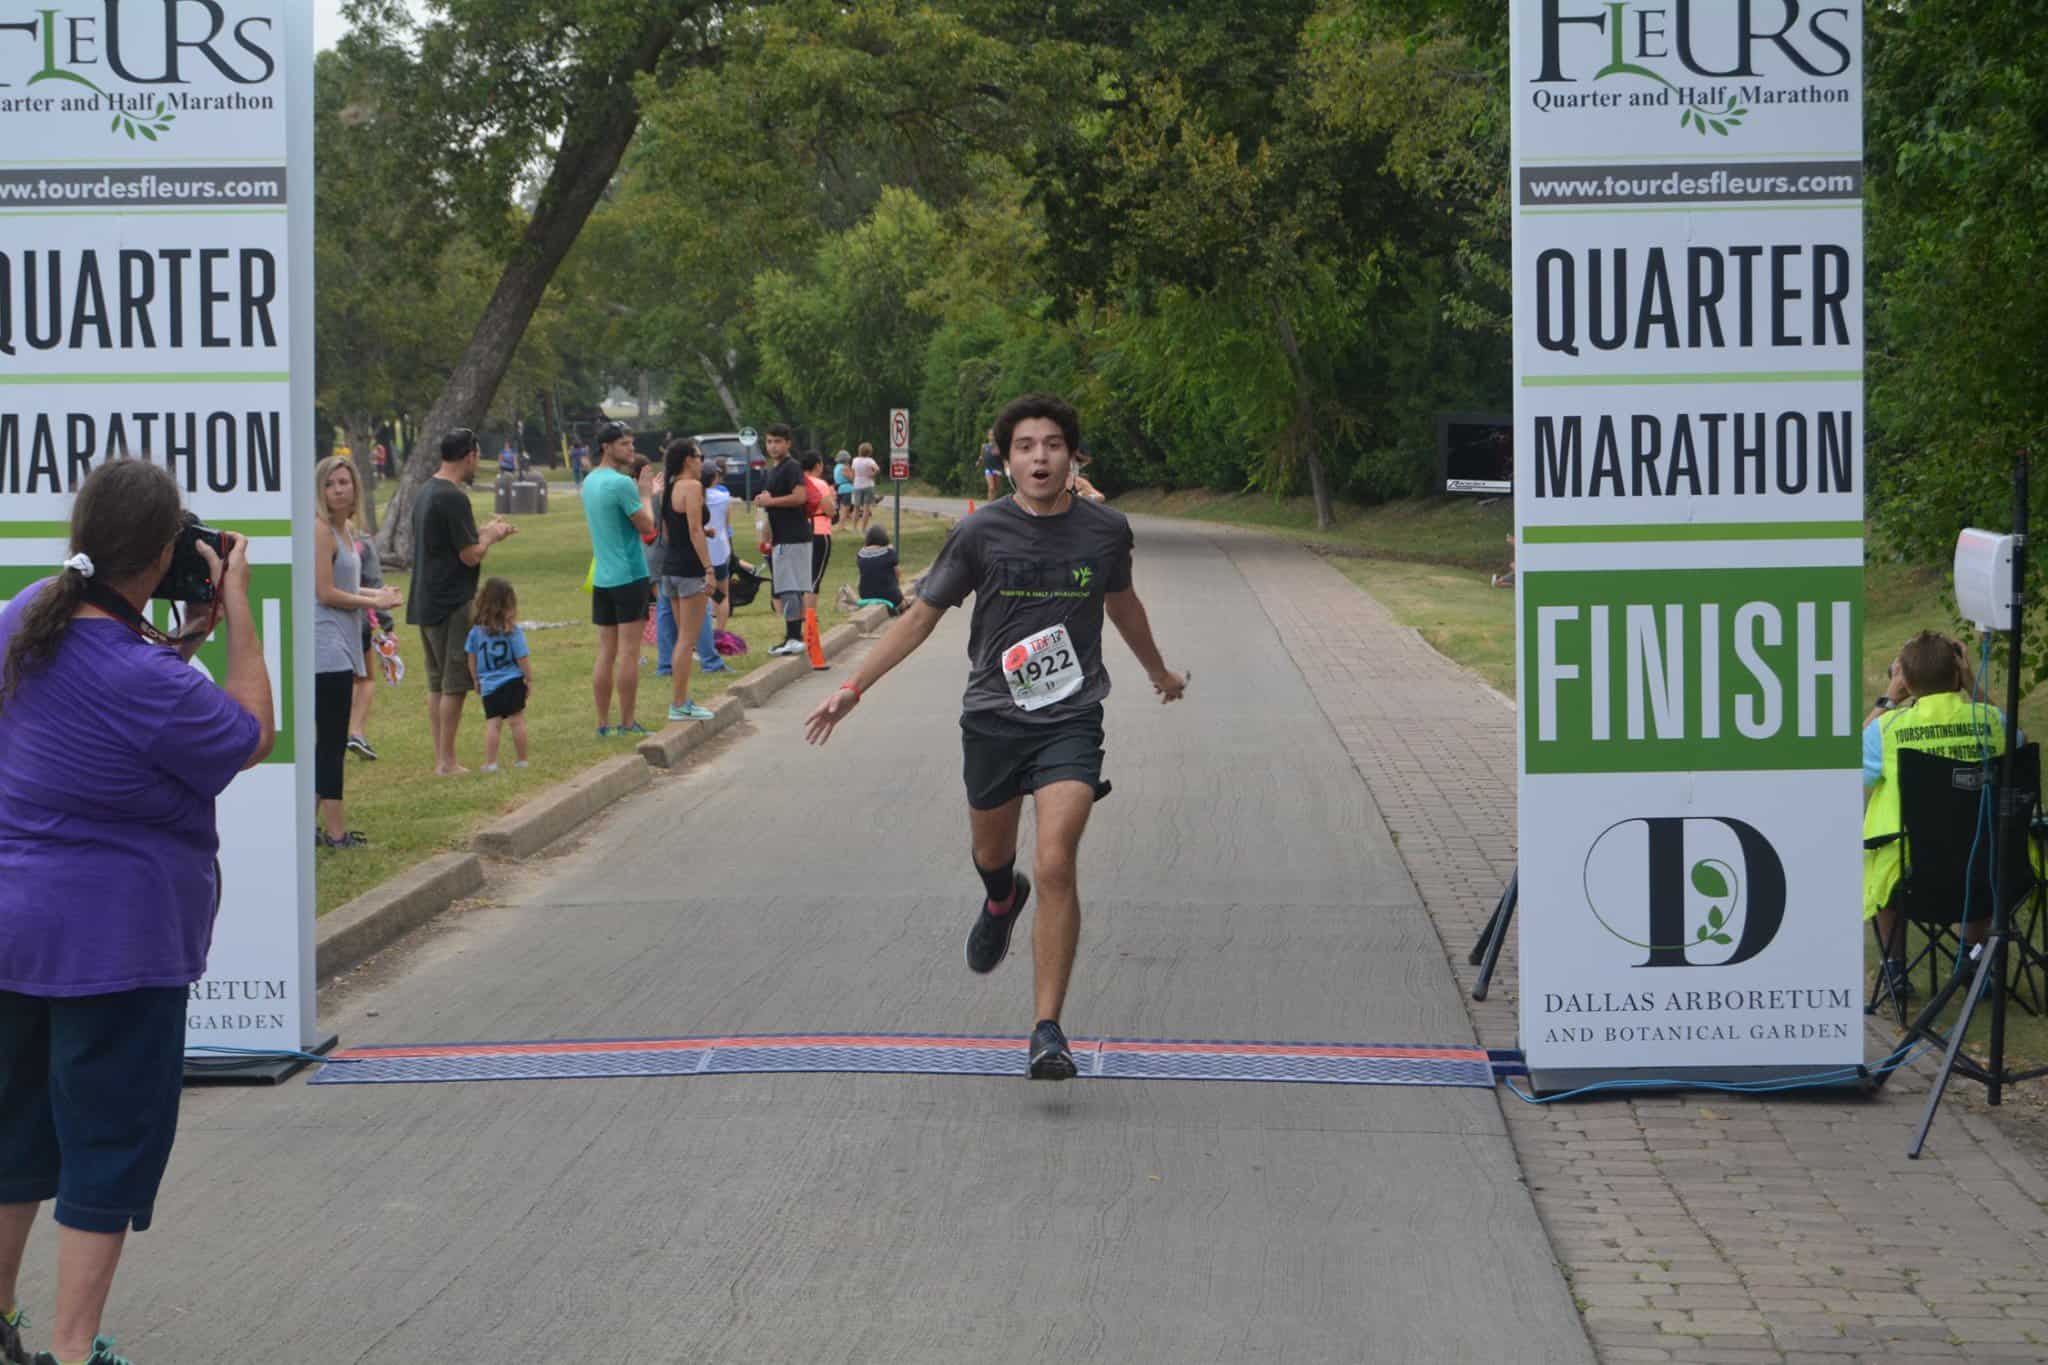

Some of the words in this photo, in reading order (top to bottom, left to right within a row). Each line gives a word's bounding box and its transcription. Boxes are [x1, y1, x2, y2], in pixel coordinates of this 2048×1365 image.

[0, 95, 54, 112] arter
[60, 93, 100, 112] and
[107, 92, 156, 111] Half
[168, 91, 273, 110] Marathon
[1532, 88, 1621, 113] Quarter
[1629, 87, 1669, 106] and
[1678, 86, 1727, 105] Half
[1740, 84, 1849, 104] Marathon
[1529, 170, 1854, 197] www.tourdesfleurs.com
[1536, 244, 1850, 357] QUARTER
[1534, 411, 1852, 498] MARATHON
[479, 639, 512, 671] 12
[1012, 649, 1074, 685] 1922
[1537, 600, 1851, 741] FINISH
[1544, 992, 1655, 1013] DALLAS
[1664, 988, 1852, 1011] ARBORETUM
[187, 1014, 285, 1030] GARDEN
[1544, 1027, 1594, 1043] AND
[1605, 1025, 1740, 1042] BOTANICAL
[1750, 1023, 1848, 1040] GARDEN
